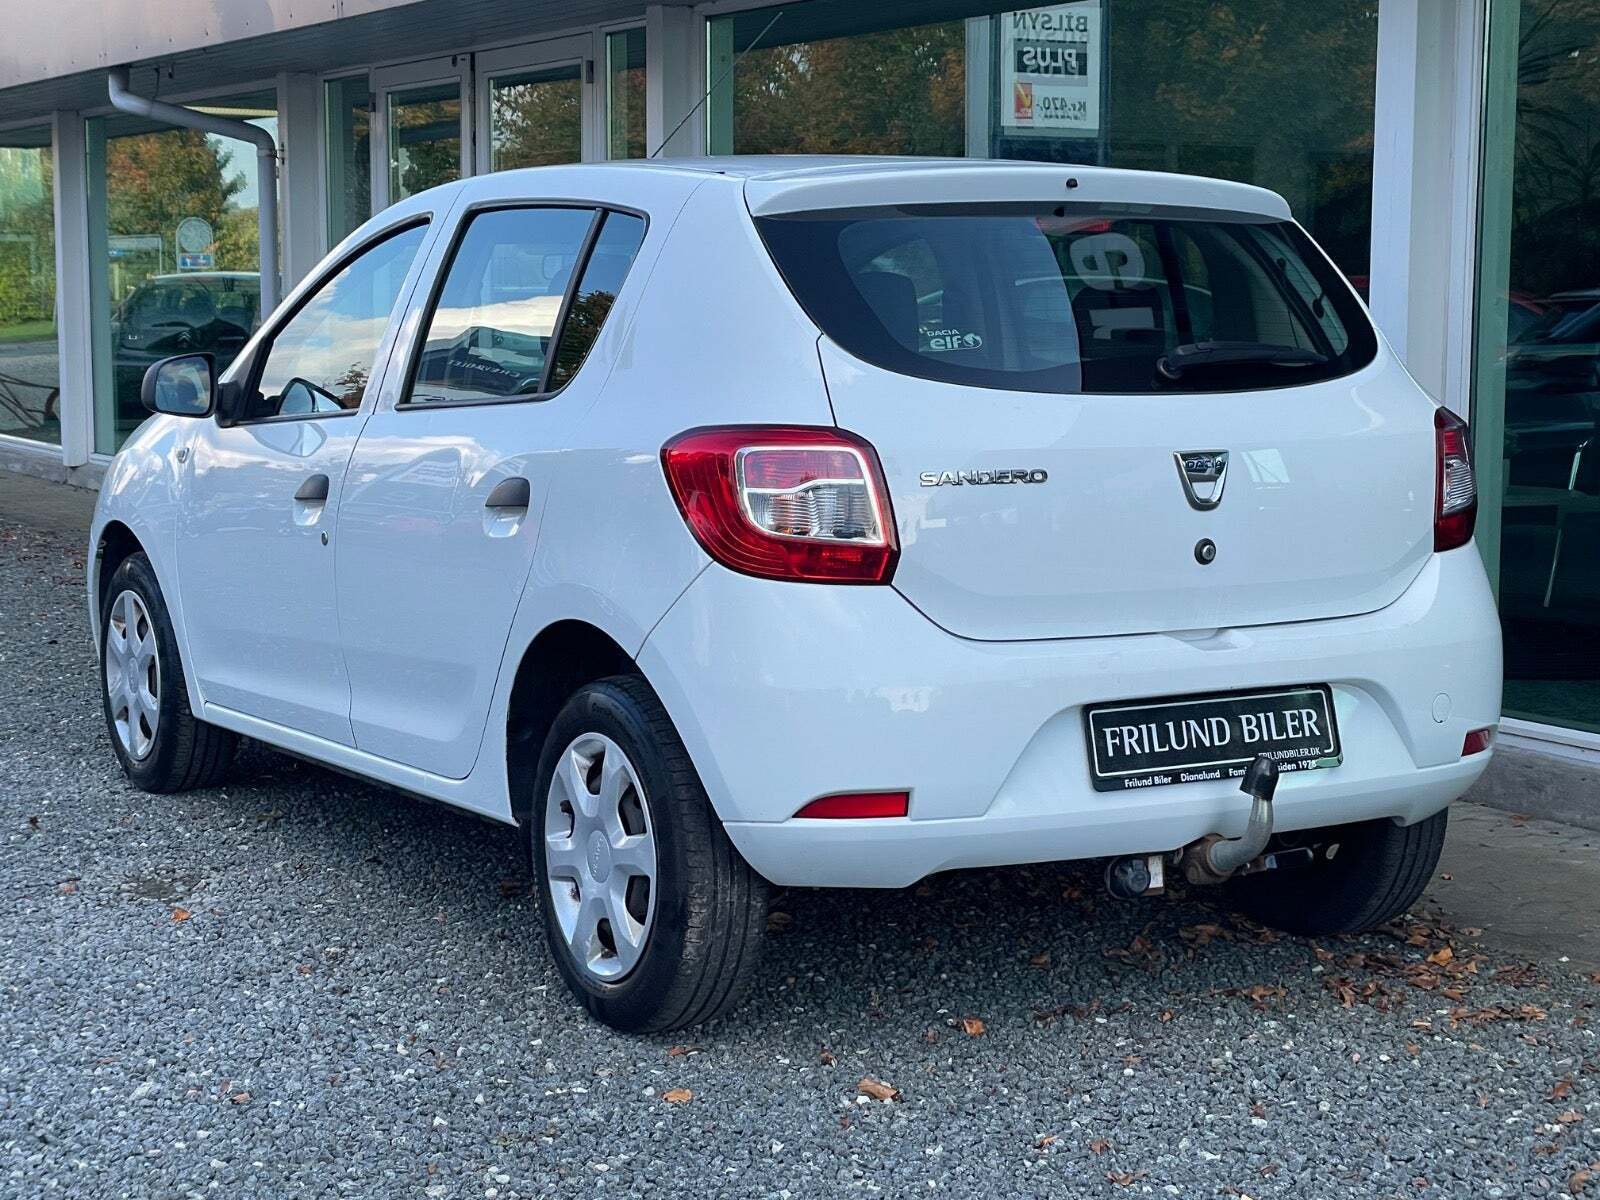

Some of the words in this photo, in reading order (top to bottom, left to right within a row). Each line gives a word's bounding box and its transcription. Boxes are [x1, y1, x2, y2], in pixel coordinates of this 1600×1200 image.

[927, 329, 960, 337] DACIA
[930, 335, 962, 349] elf
[919, 468, 1049, 488] SANDERO
[1102, 717, 1231, 757] FRILUND
[1238, 709, 1321, 743] BILER
[1124, 776, 1153, 788] Frilund
[1153, 775, 1173, 785] Biler
[1180, 769, 1221, 782] Dianalund
